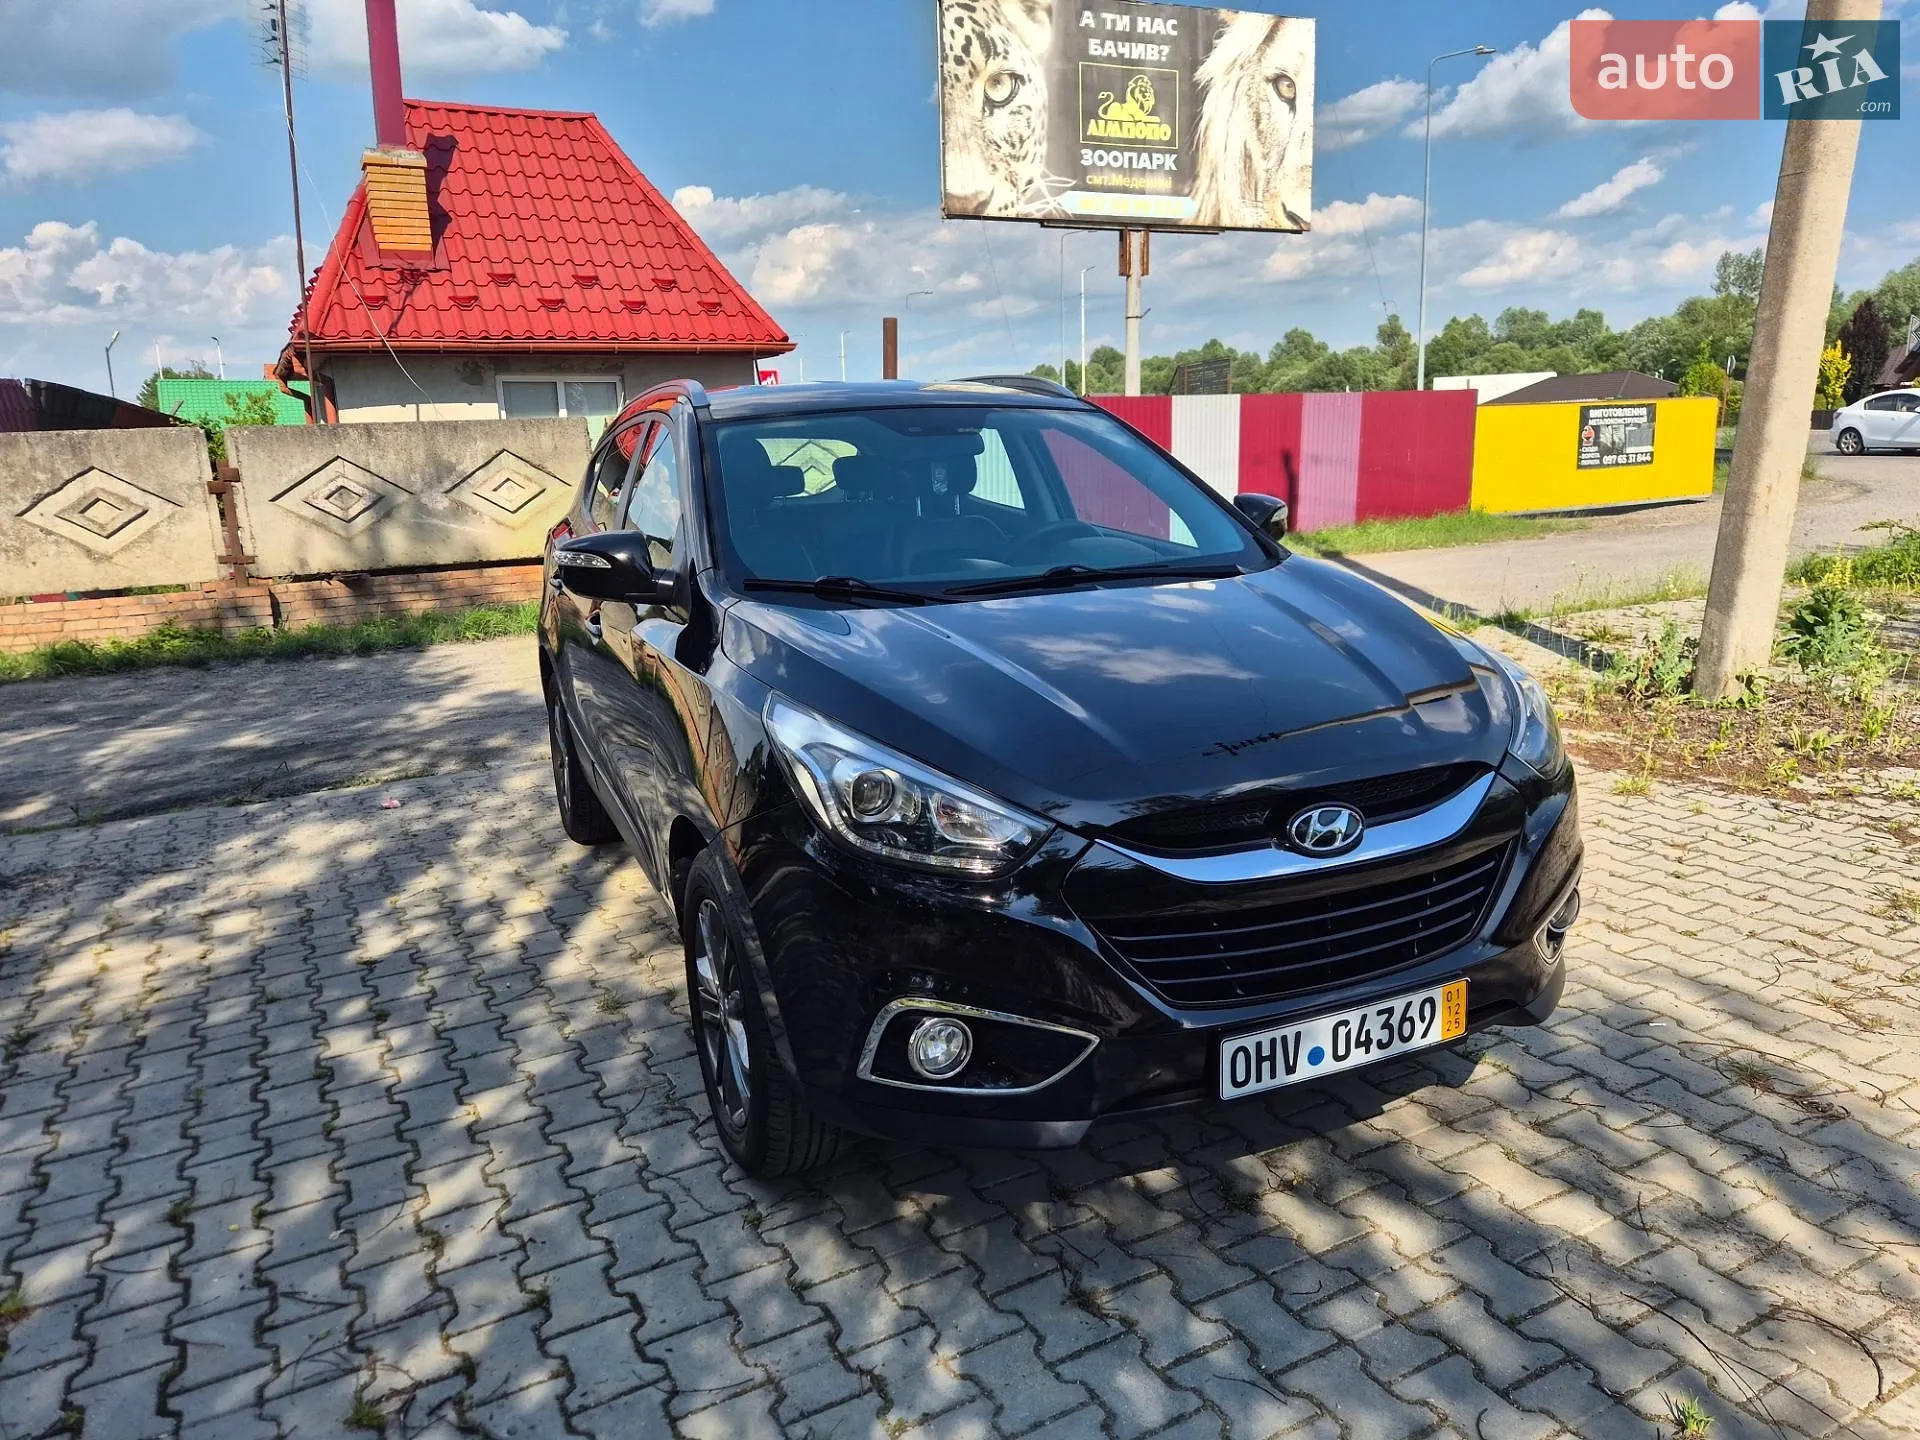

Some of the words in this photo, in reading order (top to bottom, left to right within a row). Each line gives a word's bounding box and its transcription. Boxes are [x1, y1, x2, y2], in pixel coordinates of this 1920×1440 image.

[1079, 10, 1095, 28] А
[1100, 12, 1130, 32] ТИ
[1136, 16, 1178, 36] НАС
[1088, 38, 1171, 61] БАЧИВ?
[1087, 118, 1171, 141] ЛІМПОПО
[1080, 148, 1178, 171] ЗООПАРК
[1086, 173, 1172, 189] смт.Медеі
[1446, 988, 1460, 1002] 01
[1447, 1003, 1461, 1017] 12
[1446, 1018, 1460, 1032] 25
[1230, 1031, 1302, 1089] OHV
[1331, 996, 1437, 1062] 04369
